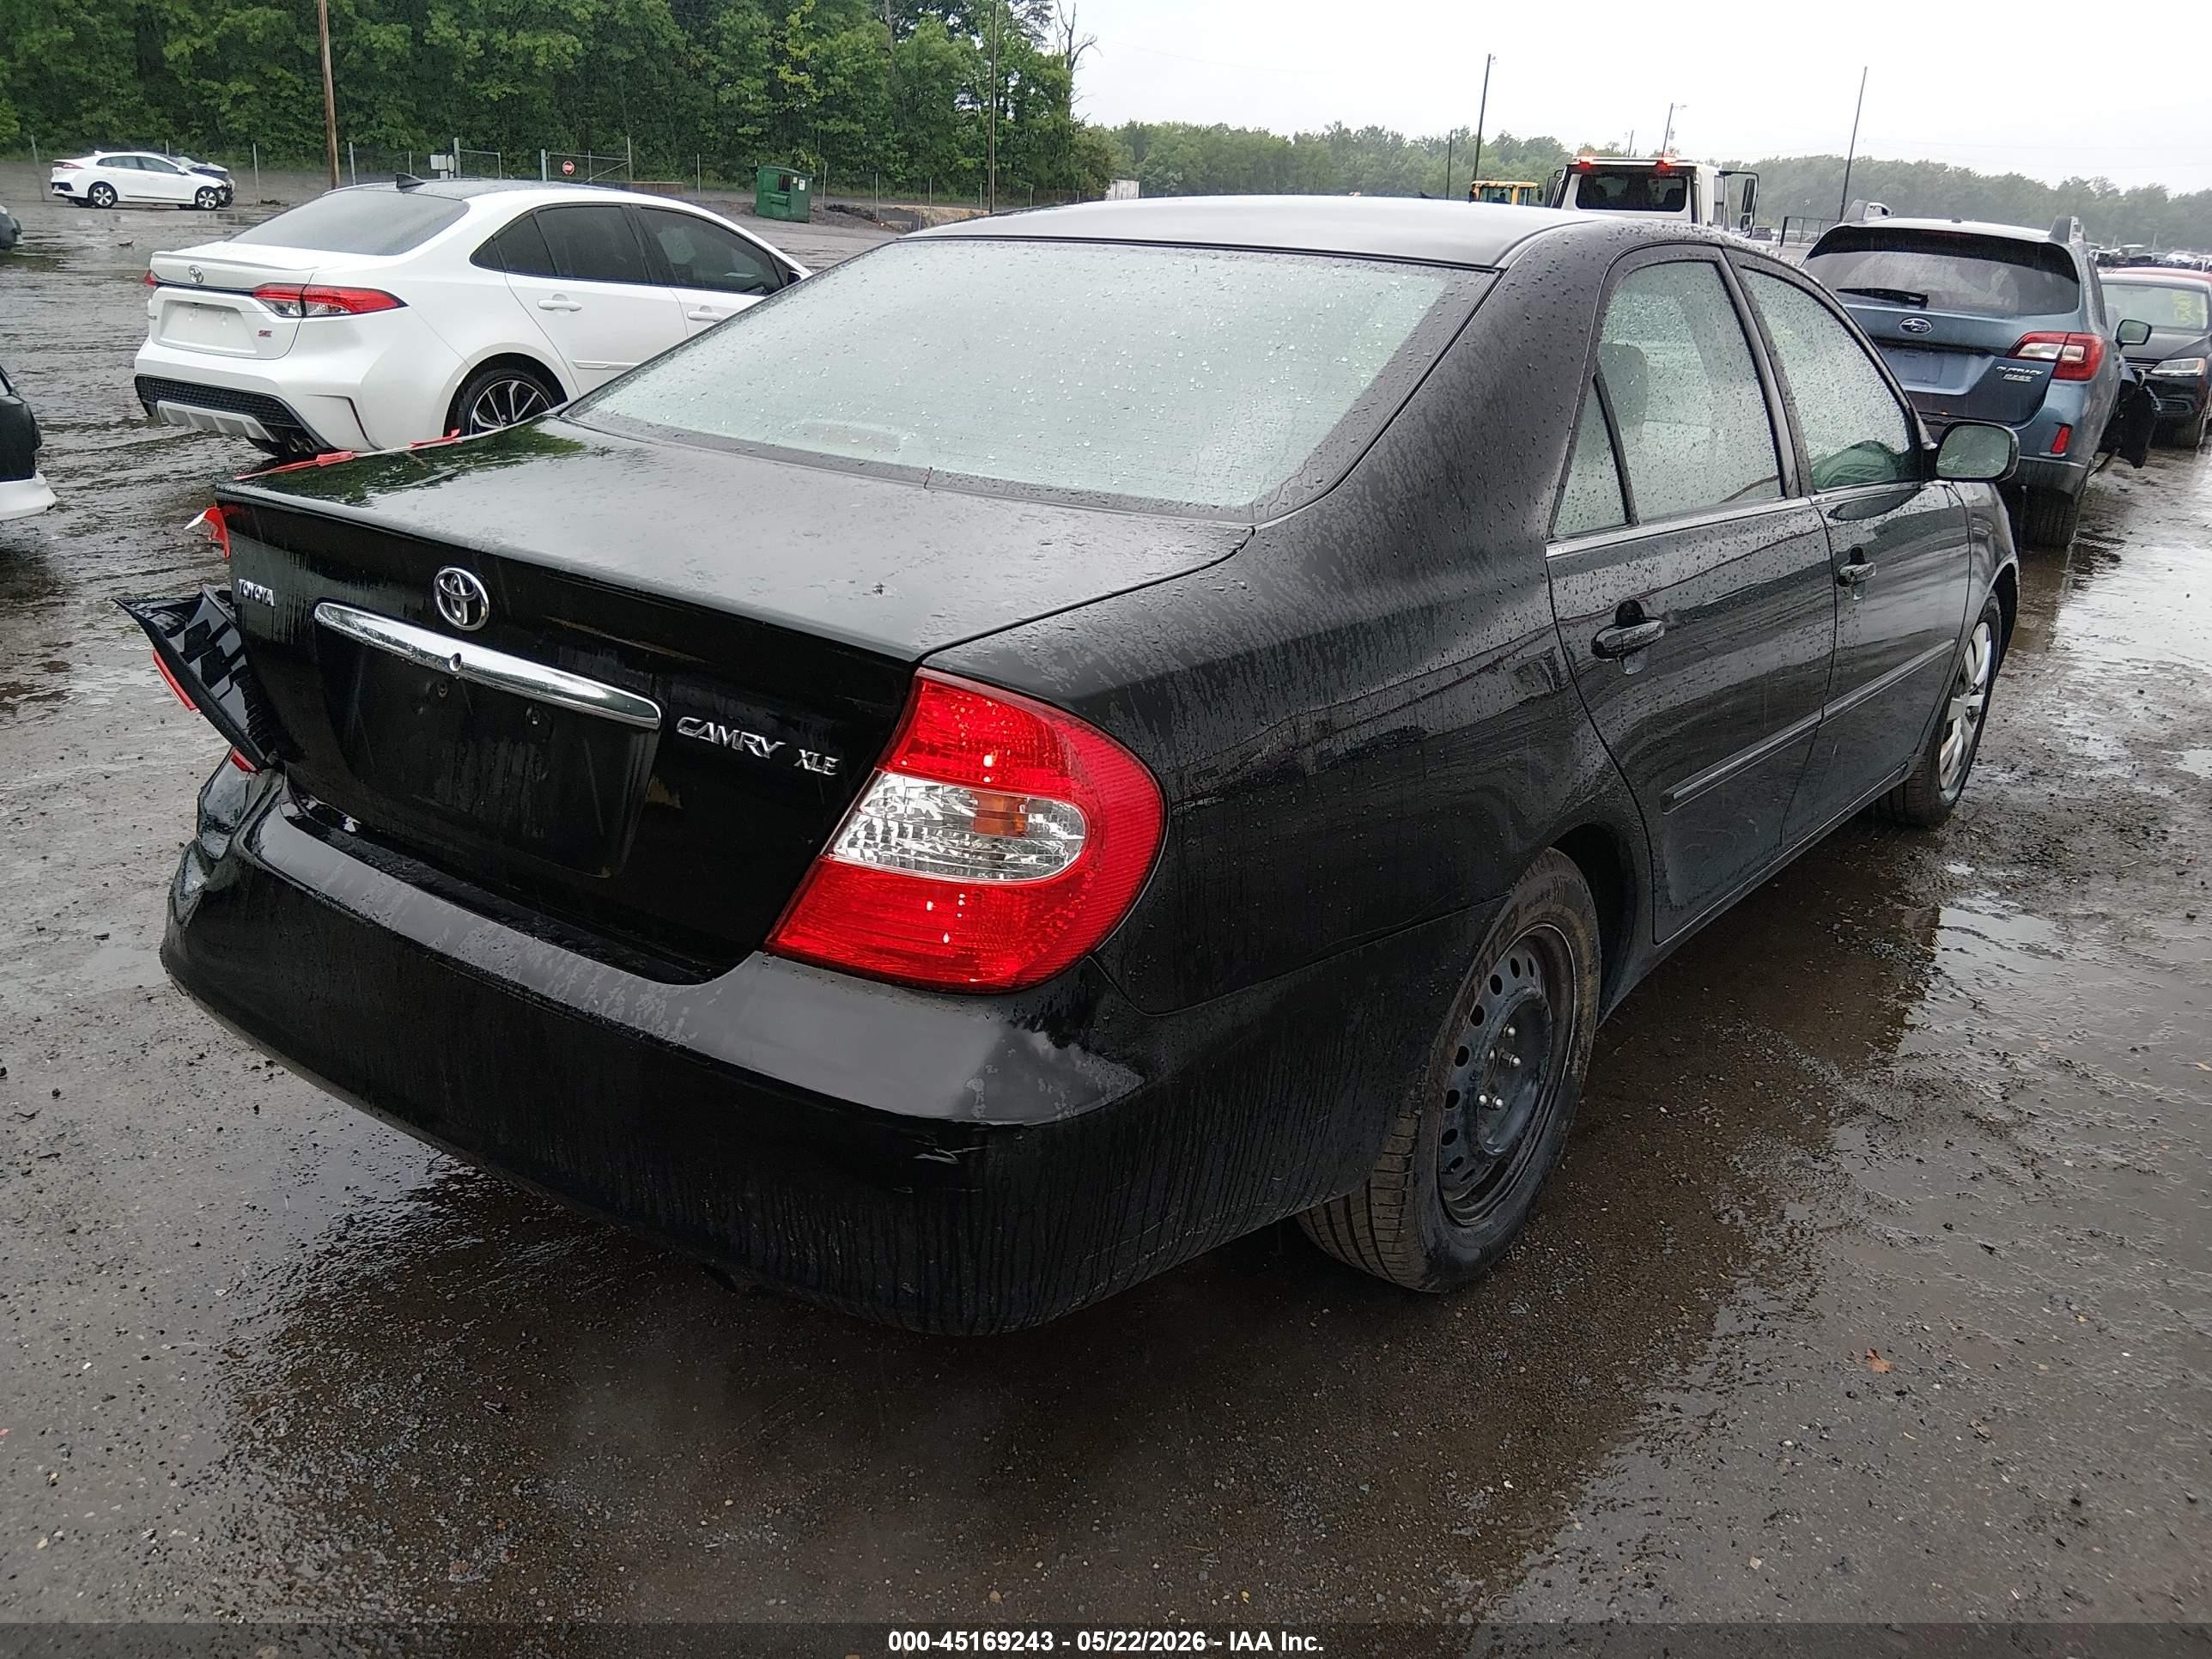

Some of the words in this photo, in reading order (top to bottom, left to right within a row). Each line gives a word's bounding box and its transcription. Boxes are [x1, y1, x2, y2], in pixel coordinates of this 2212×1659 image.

[238, 578, 275, 606] TOYOTA
[676, 716, 787, 759] CAMRY
[793, 749, 841, 775] XLE
